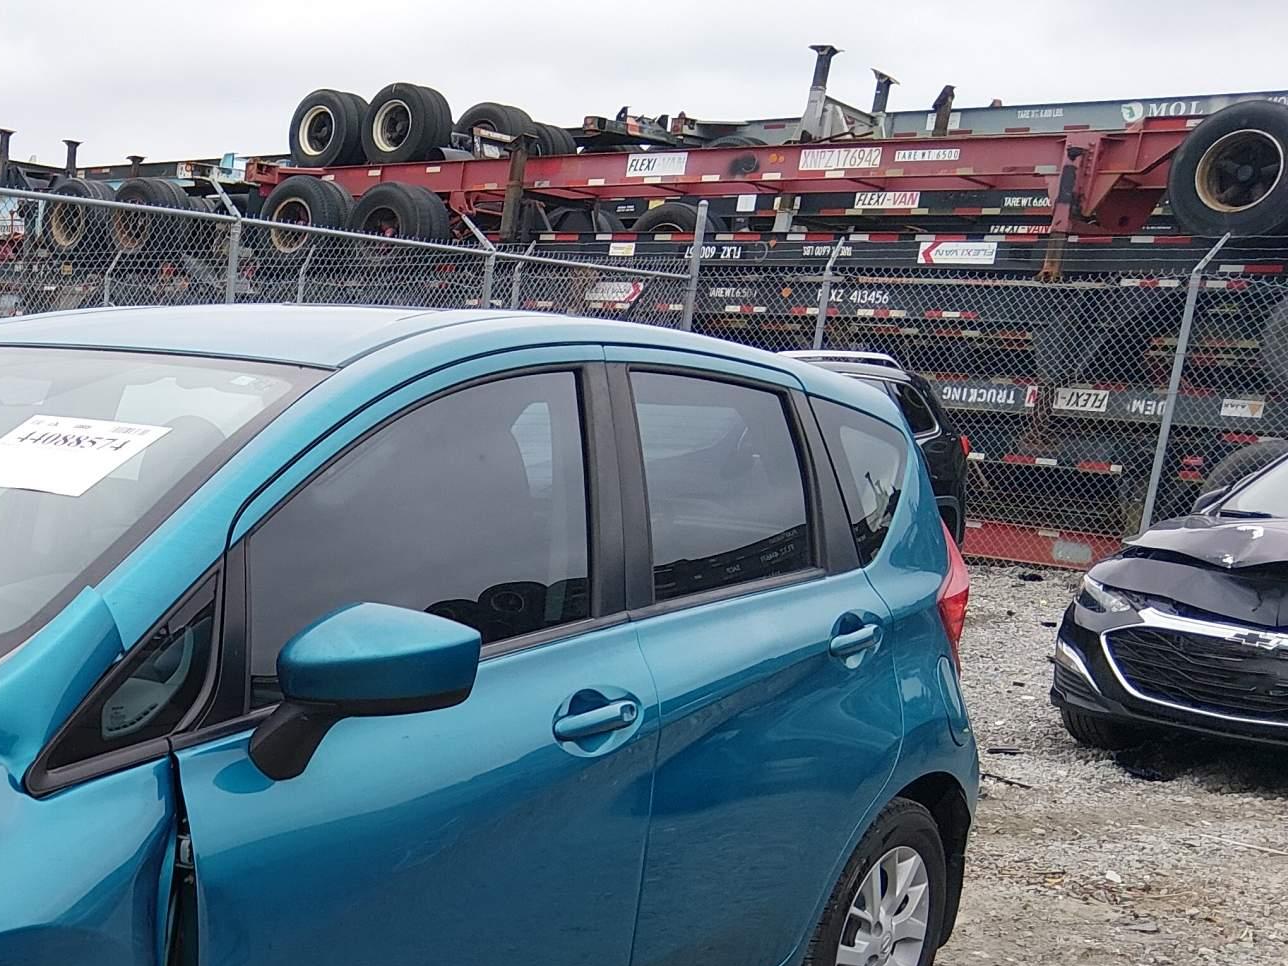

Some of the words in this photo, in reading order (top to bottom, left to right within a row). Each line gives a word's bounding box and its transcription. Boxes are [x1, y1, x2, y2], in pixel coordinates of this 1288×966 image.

[1149, 101, 1203, 117] MOL
[897, 150, 918, 161] TARE
[937, 150, 959, 161] 6500
[856, 192, 918, 207] FLEXI-VAN
[1004, 198, 1021, 207] TARE
[817, 289, 844, 302] FXZ
[850, 291, 889, 304] 413456
[943, 386, 1016, 404] TRUCKING
